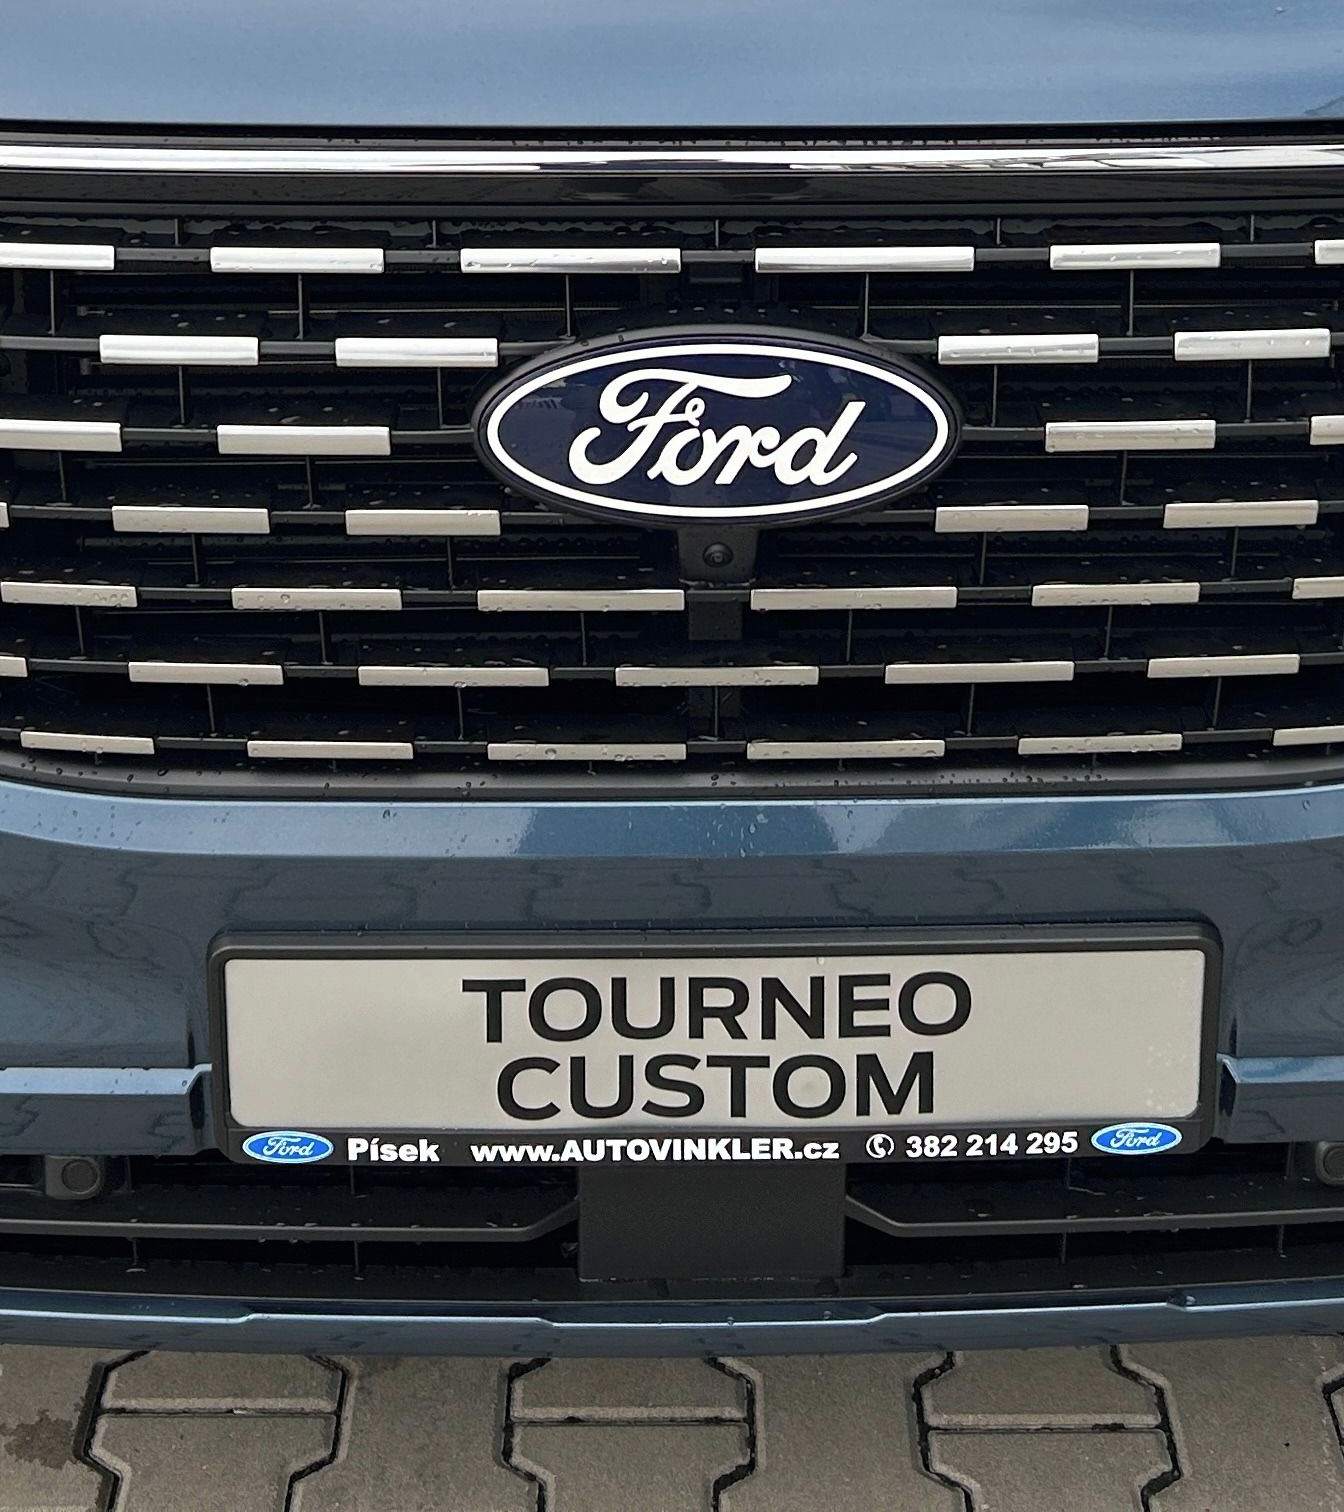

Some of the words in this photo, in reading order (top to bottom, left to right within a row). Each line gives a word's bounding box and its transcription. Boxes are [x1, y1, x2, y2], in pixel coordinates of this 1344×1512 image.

[568, 368, 866, 486] Ford
[461, 971, 973, 1043] TOURNEO
[496, 1051, 935, 1121] CUSTOM
[262, 1136, 315, 1157] Ford
[347, 1136, 441, 1163] Písek
[469, 1138, 840, 1163] www.AUTOVINKLER.cz
[905, 1134, 958, 1158] 382
[965, 1133, 1019, 1157] 214
[1026, 1131, 1079, 1155] 295
[1109, 1127, 1162, 1150] Ford
